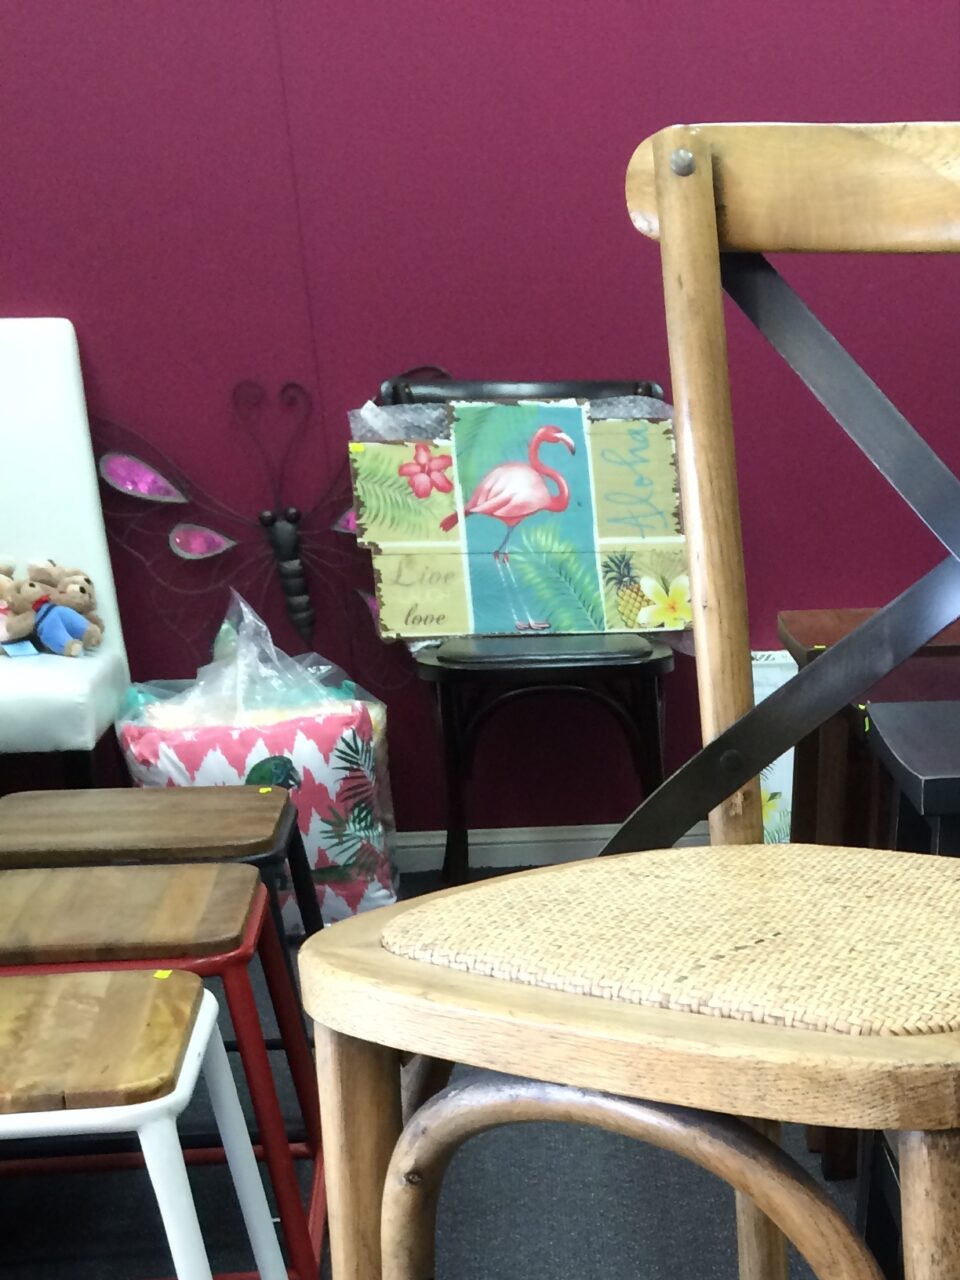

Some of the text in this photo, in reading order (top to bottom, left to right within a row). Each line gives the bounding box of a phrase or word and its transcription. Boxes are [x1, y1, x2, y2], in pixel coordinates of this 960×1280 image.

[602, 423, 670, 538] Aloha
[391, 559, 457, 588] Live
[404, 602, 447, 627] love
